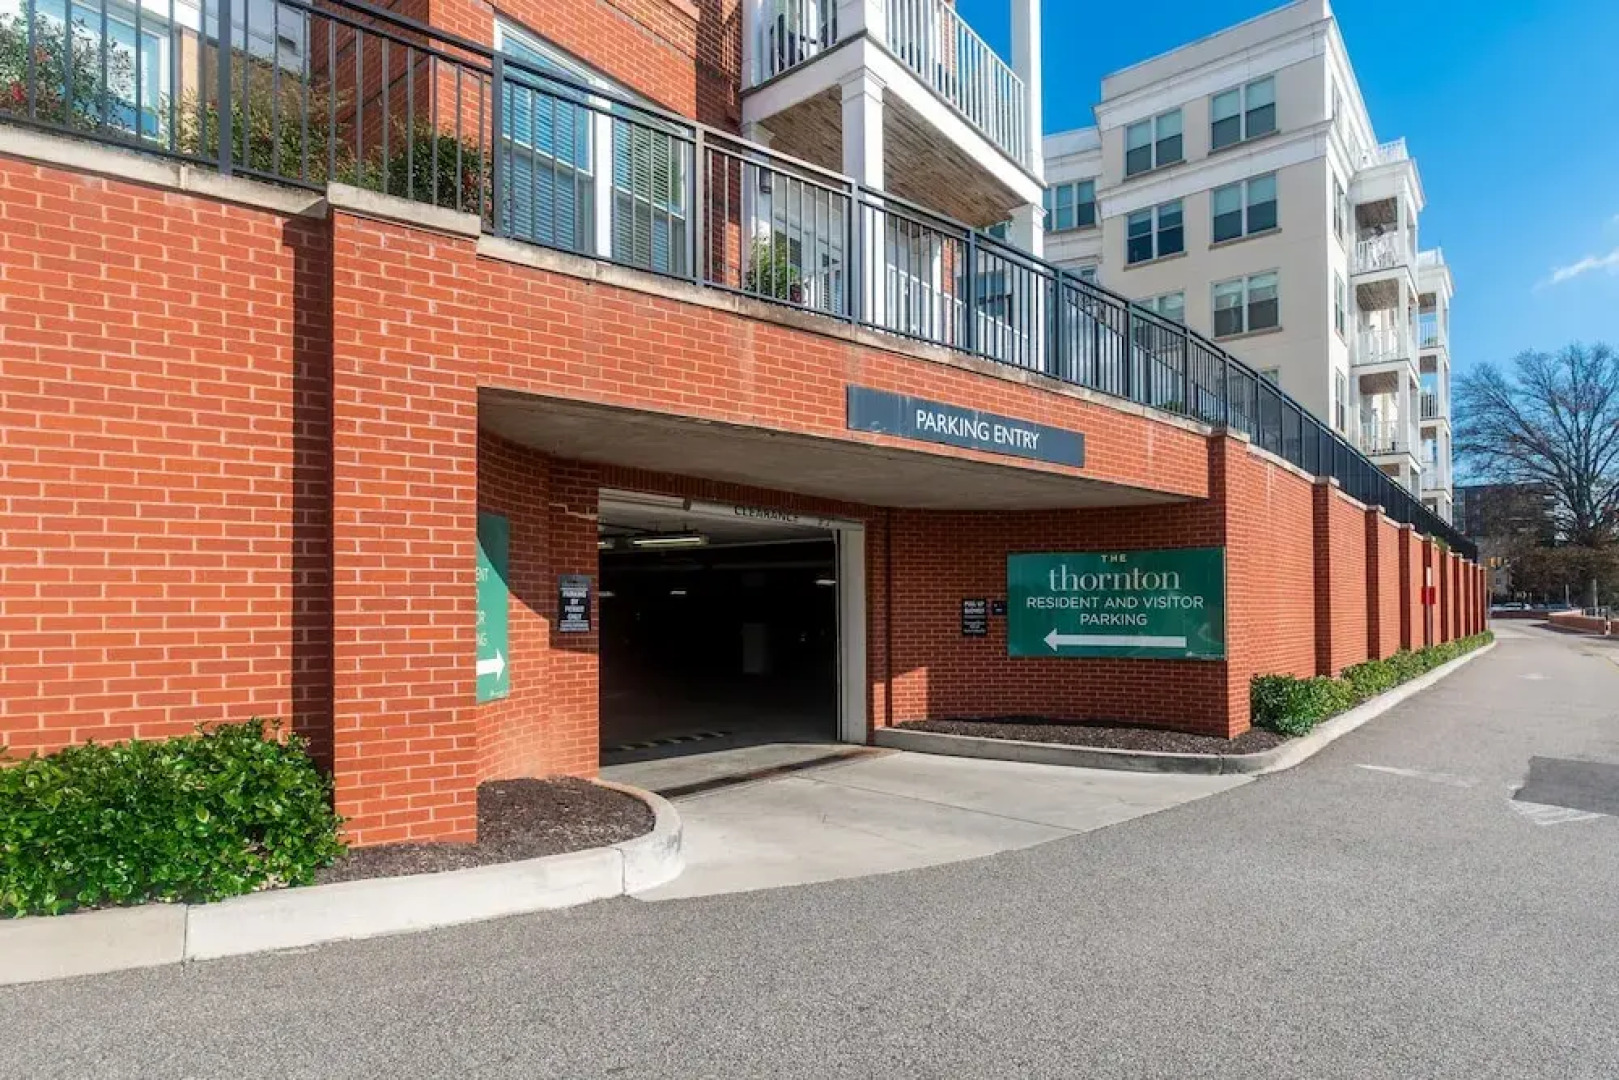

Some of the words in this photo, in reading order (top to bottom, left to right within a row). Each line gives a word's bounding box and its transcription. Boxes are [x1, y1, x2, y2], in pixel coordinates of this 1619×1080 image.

[916, 409, 990, 442] PARKING
[993, 425, 1040, 450] ENTRY
[1101, 554, 1128, 563] THE
[1049, 564, 1181, 591] thornton
[1026, 597, 1099, 608] RESIDENT
[1104, 597, 1139, 608] AND
[1143, 595, 1204, 608] VISITOR
[1080, 613, 1148, 626] PARKING
